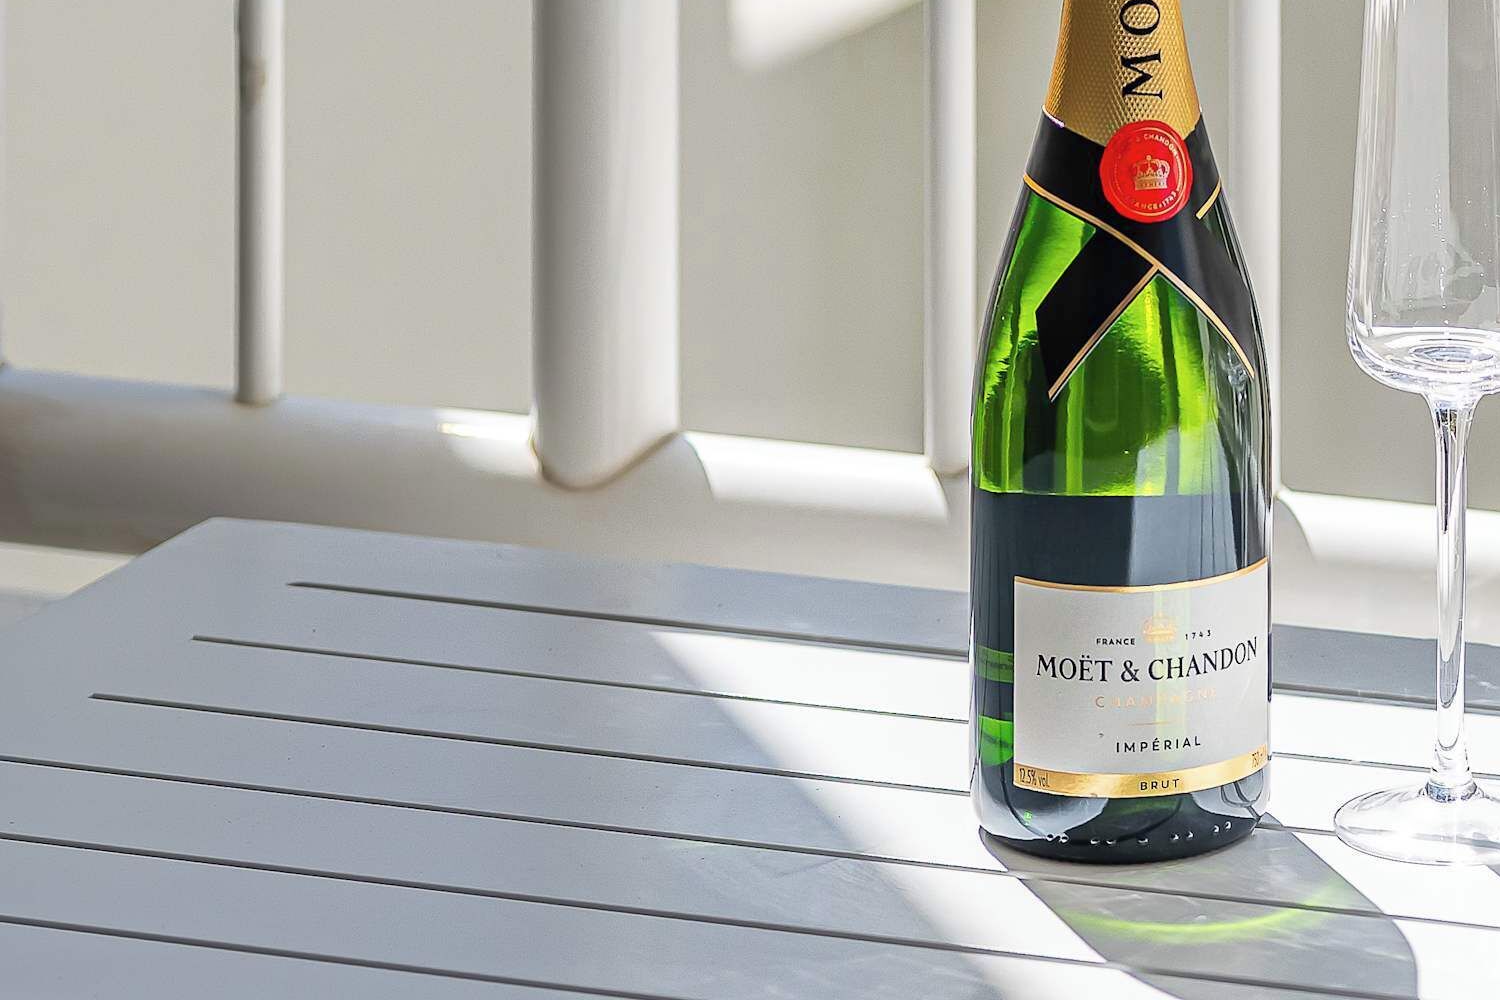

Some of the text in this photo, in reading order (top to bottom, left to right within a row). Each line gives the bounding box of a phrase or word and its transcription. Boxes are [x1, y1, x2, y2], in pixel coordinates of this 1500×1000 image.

[1096, 629, 1211, 646] FRANCE 1743
[1036, 635, 1257, 683] MOËT & CHANDON
[1116, 736, 1202, 753] IMPÉRIAL
[1140, 778, 1180, 791] BRUT
